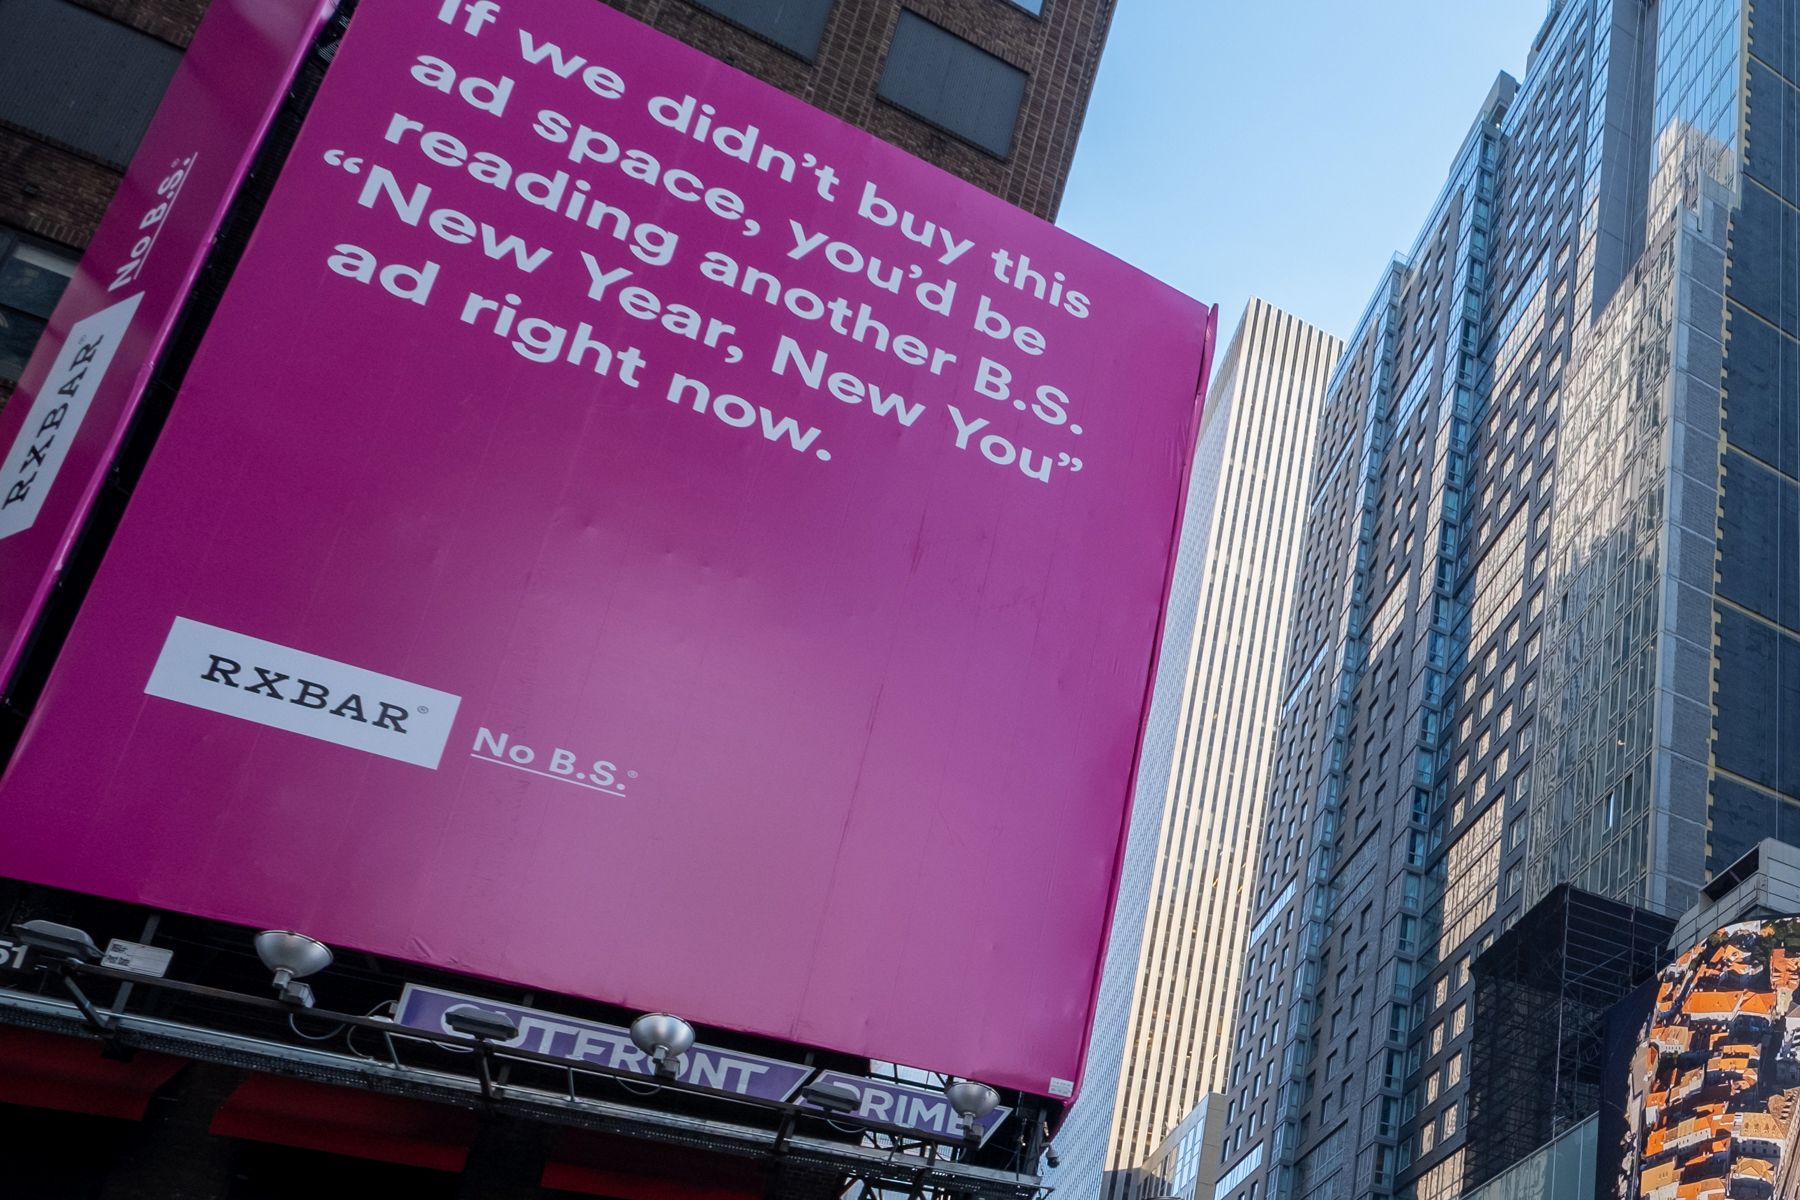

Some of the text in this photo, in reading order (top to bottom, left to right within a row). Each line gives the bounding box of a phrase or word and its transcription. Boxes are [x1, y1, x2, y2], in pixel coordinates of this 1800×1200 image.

[109, 157, 192, 293] No B.S.
[410, 53, 1046, 356] ad space, you’d be
[437, 0, 1091, 318] If we didn’t buy this
[328, 242, 832, 461] ad right now.
[384, 112, 1083, 435] reading another B.S.
[580, 250, 743, 363] Year,
[772, 338, 926, 427] New
[3, 334, 104, 508] RXBAR
[201, 654, 409, 733] RXBAR
[472, 727, 626, 791] No B.S.
